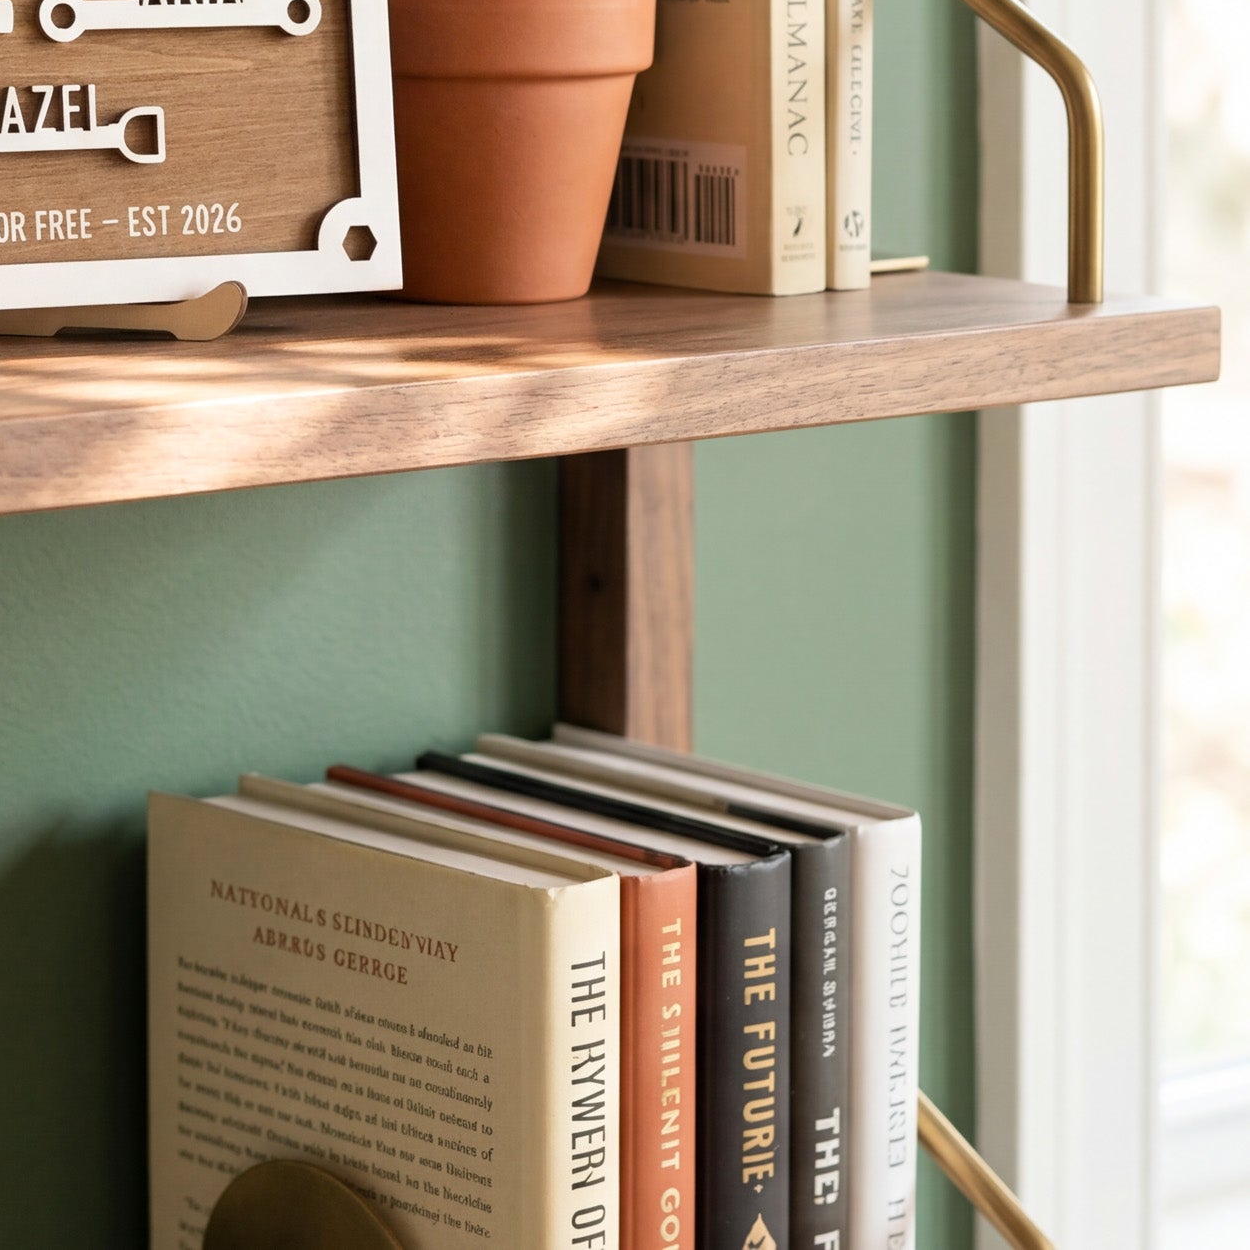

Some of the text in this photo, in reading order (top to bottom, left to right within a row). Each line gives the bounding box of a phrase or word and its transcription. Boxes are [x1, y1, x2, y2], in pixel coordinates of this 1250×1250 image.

[35, 208, 92, 241] FREE
[128, 204, 171, 236] EST
[181, 202, 242, 235] 2026
[570, 950, 607, 1028] THE
[660, 918, 683, 989] THE
[743, 927, 777, 1006] THE
